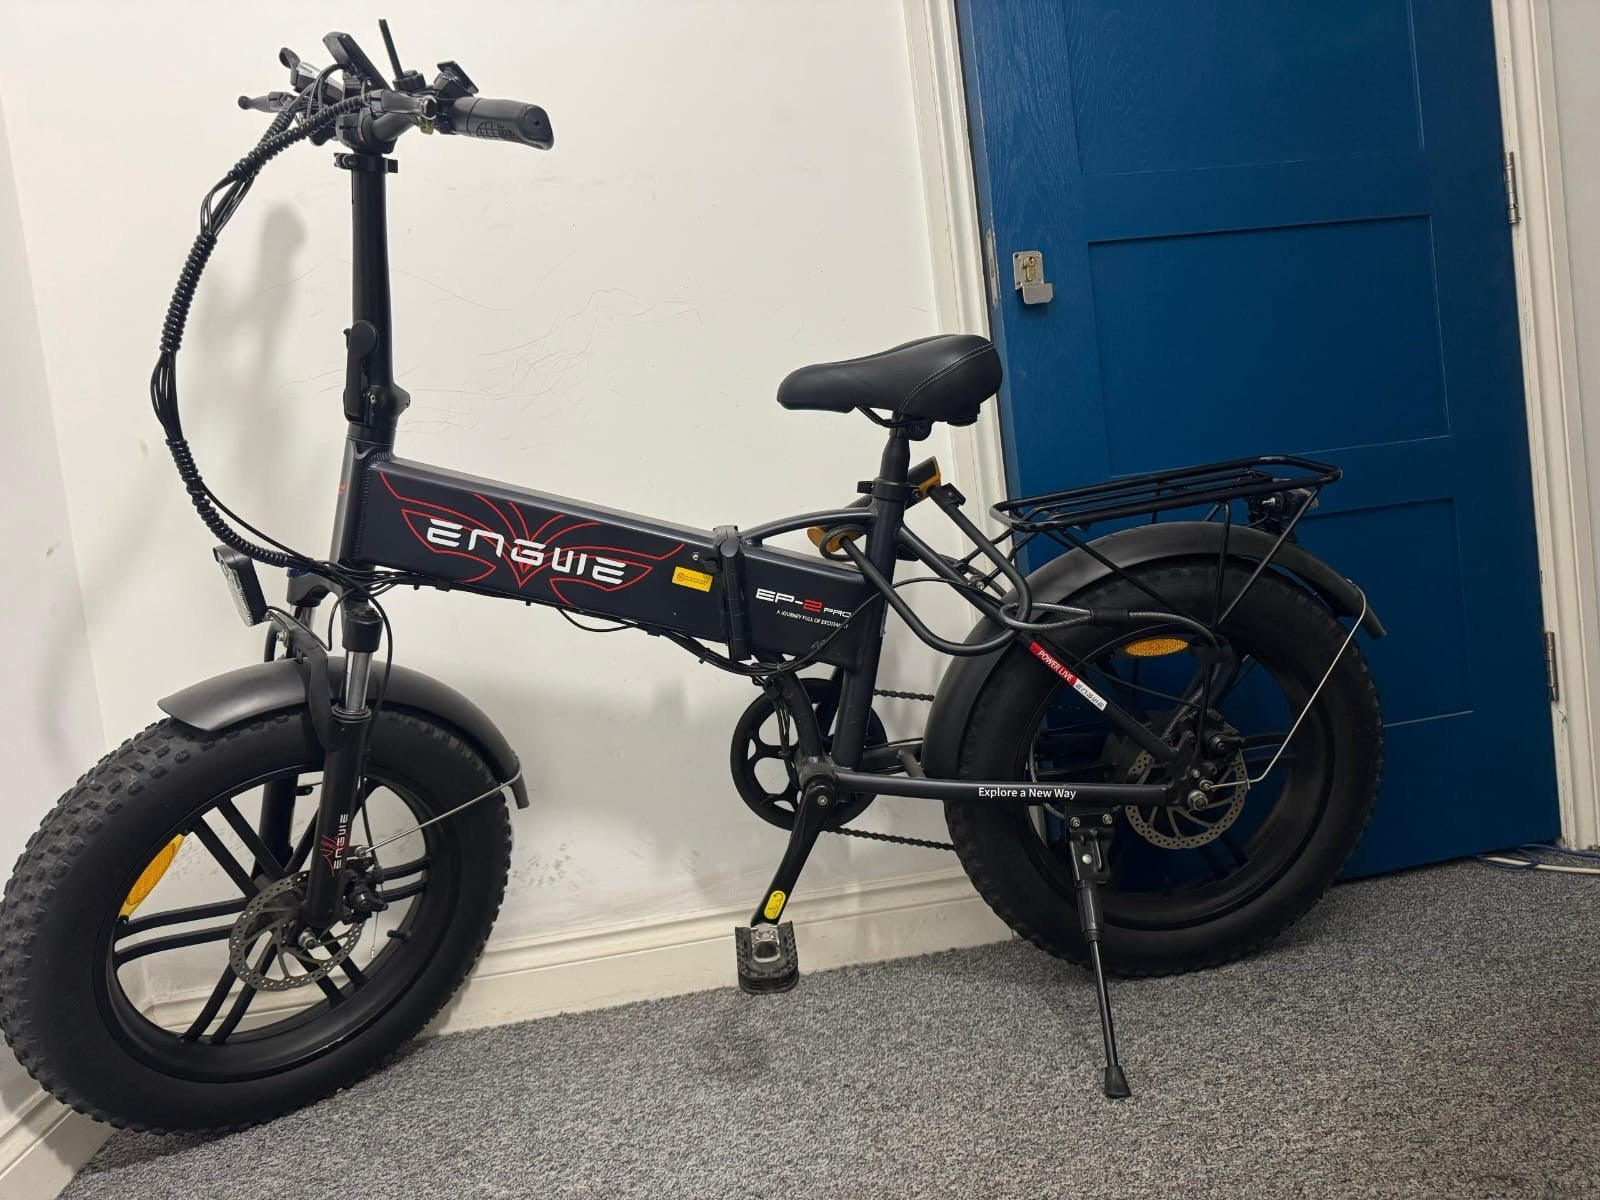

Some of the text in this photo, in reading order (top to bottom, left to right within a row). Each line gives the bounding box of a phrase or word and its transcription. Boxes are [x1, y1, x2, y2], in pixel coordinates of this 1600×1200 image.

[1038, 650, 1061, 671] POWER
[1059, 665, 1074, 682] LIVE
[978, 786, 1077, 800] Explore a New Way
